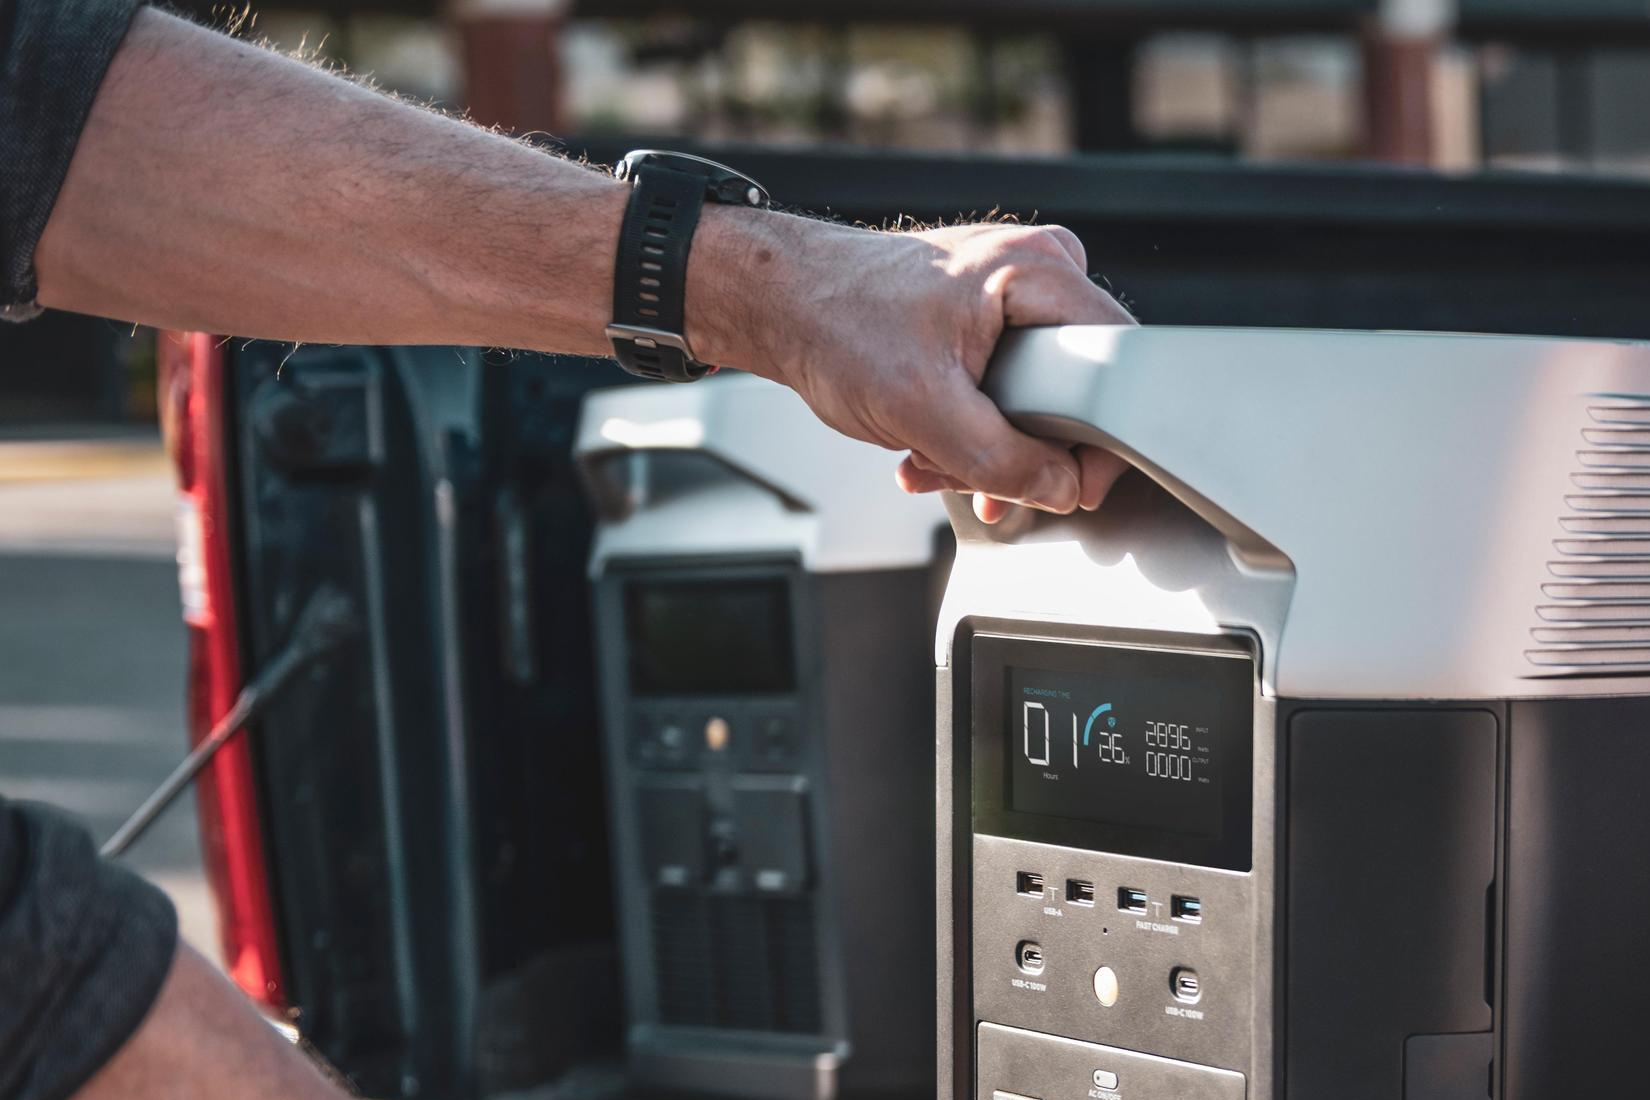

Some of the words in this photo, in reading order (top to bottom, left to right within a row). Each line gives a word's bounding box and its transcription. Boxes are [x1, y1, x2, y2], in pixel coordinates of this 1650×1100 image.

[1146, 720, 1191, 751] 2896
[1043, 771, 1059, 780] Hours
[1146, 751, 1192, 781] 0000
